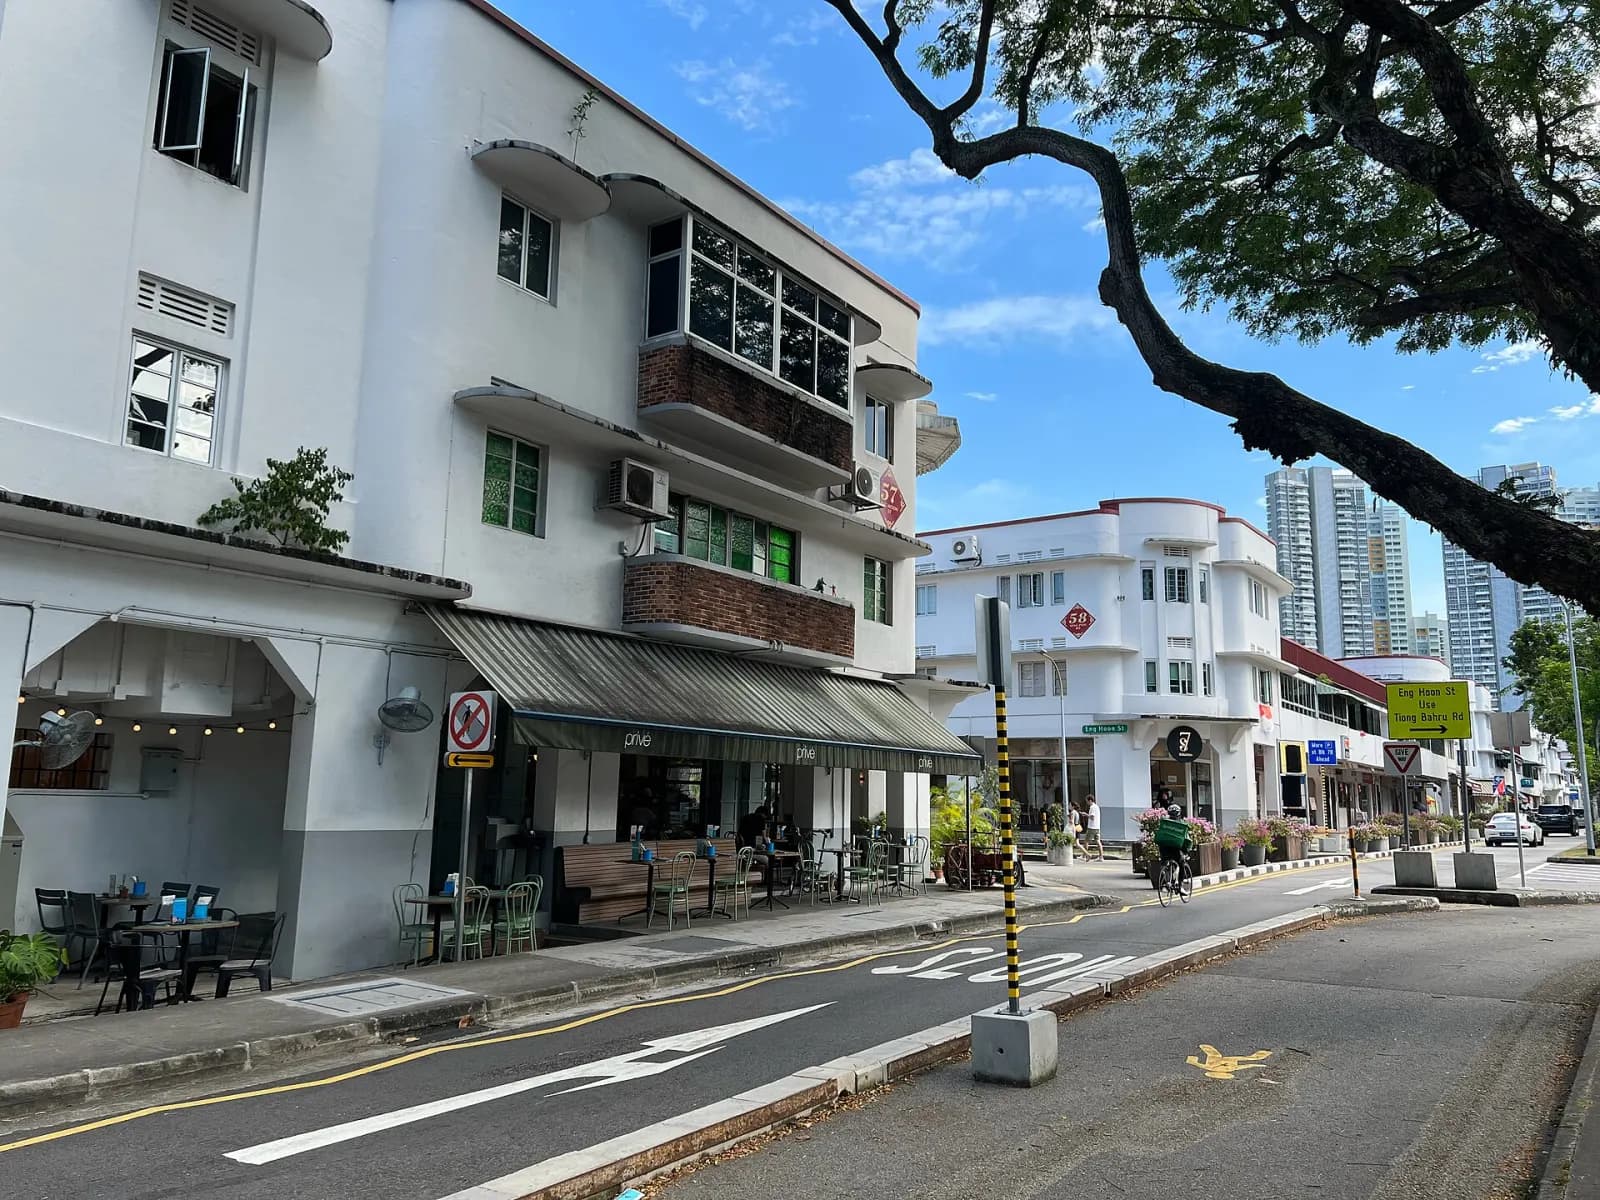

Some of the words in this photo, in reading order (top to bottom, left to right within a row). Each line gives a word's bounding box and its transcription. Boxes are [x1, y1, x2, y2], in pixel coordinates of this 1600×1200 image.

[881, 483, 898, 504] 57
[1068, 612, 1087, 624] 58
[1398, 688, 1414, 698] Eng
[1418, 687, 1441, 697] Hoon
[1445, 686, 1456, 696] St
[1418, 700, 1436, 709] Use
[1394, 713, 1417, 723] Tiong
[1421, 712, 1448, 722] Bahru
[1452, 711, 1464, 721] Rd
